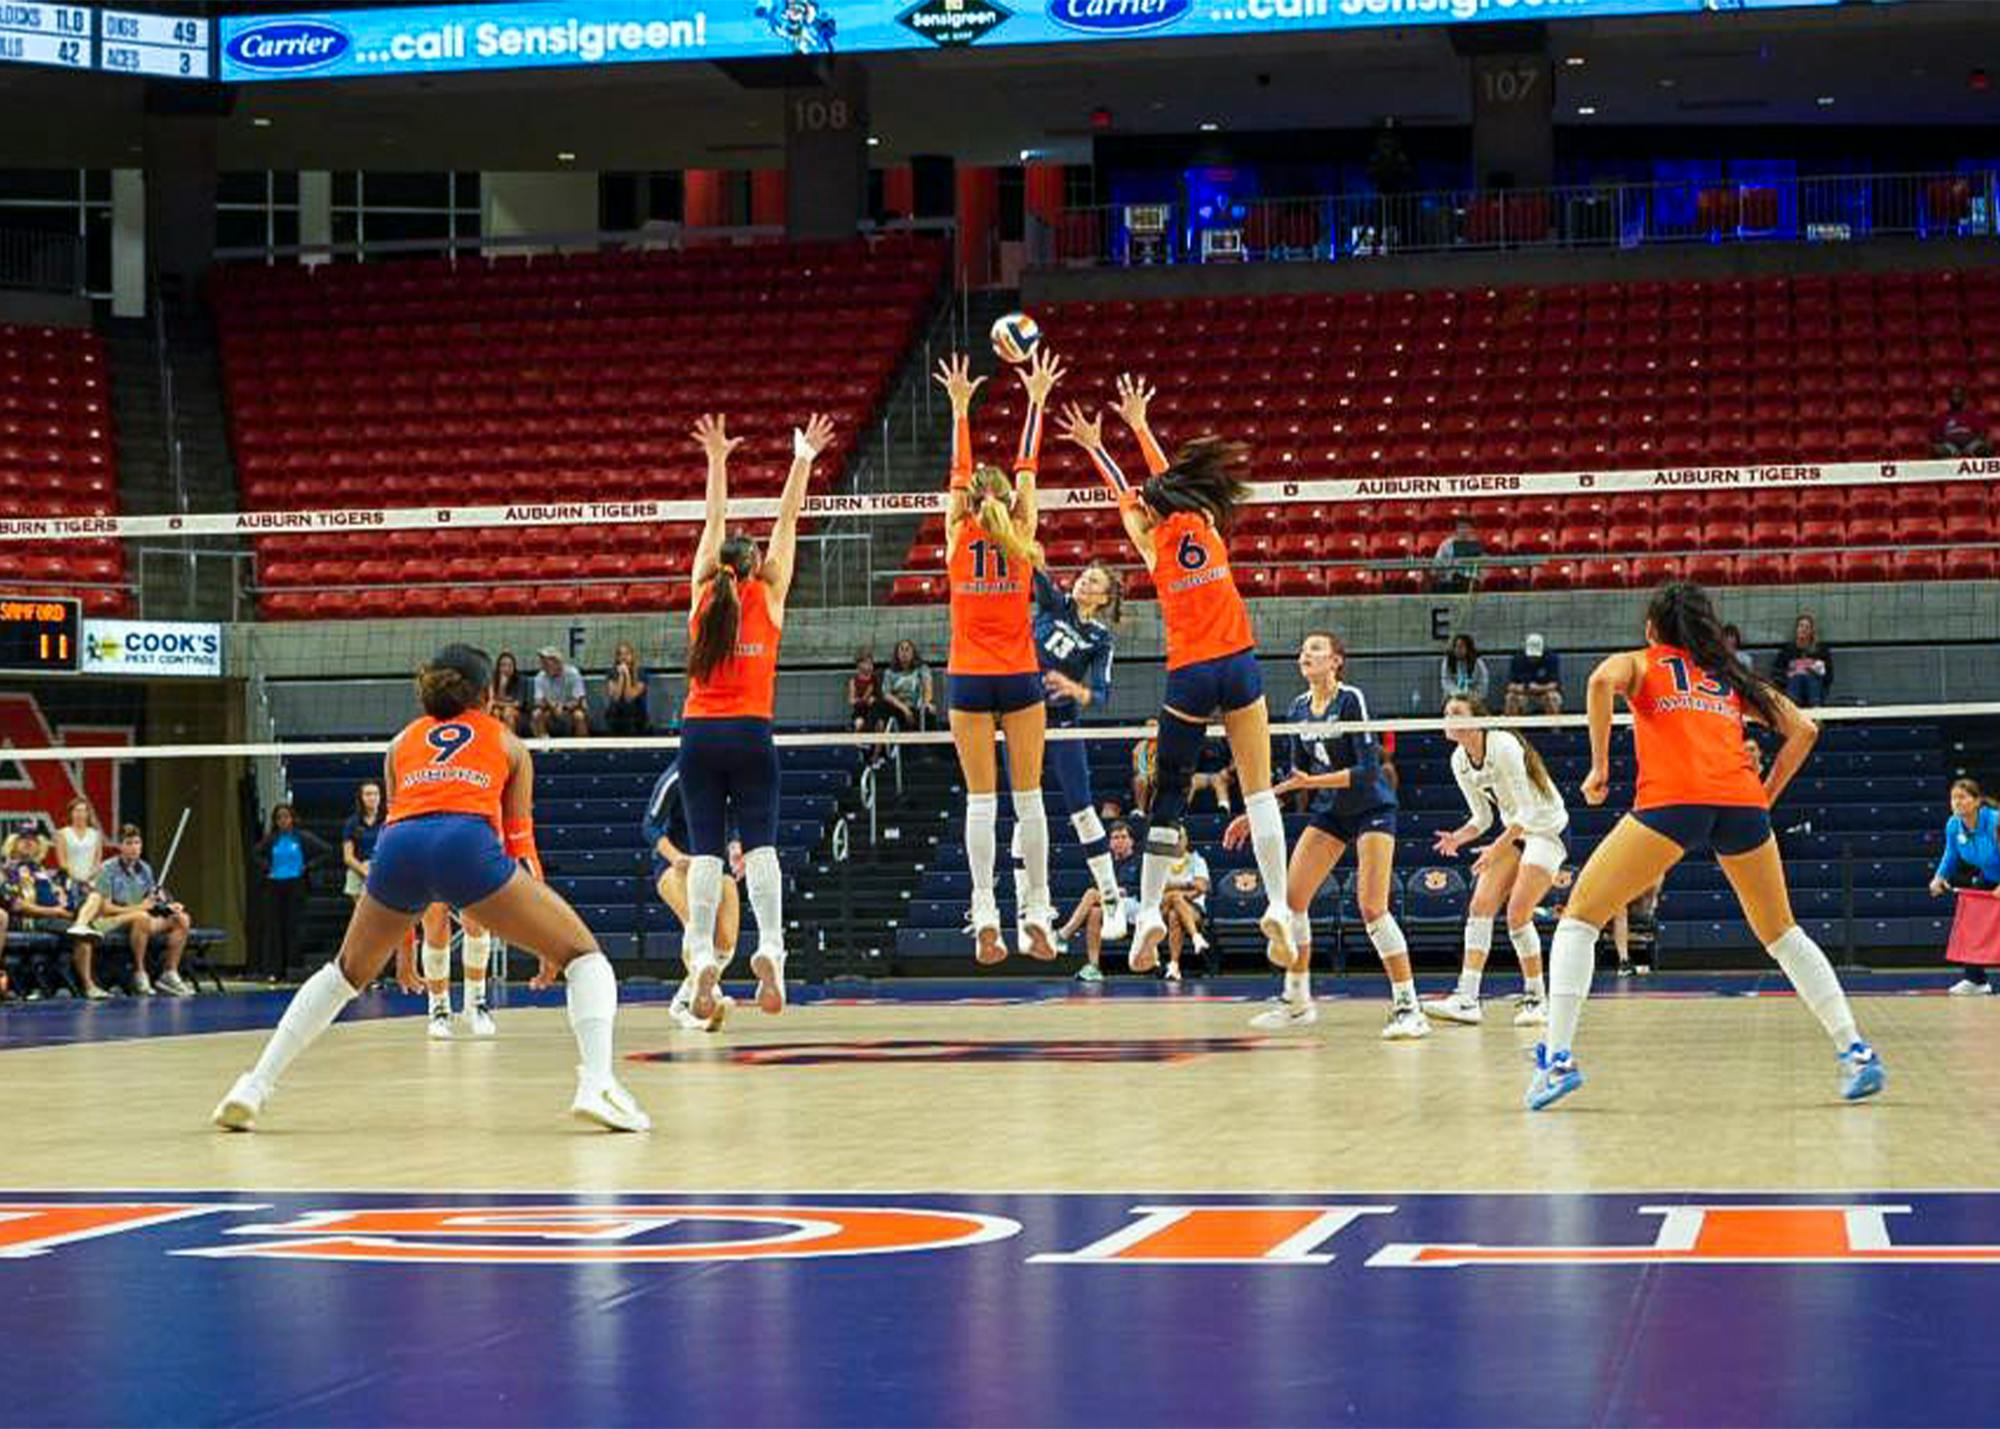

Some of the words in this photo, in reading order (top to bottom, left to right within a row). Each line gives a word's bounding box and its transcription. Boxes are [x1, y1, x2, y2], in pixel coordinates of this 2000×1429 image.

[912, 10, 997, 29] Sensigreen
[174, 22, 198, 43] 49
[475, 11, 708, 62] Sensigreen!
[57, 41, 81, 64] 42
[240, 31, 337, 58] Carrier
[179, 53, 191, 74] 3
[1486, 68, 1538, 103] 107
[795, 100, 848, 133] 108
[1355, 479, 1441, 495] AUBURN
[1448, 476, 1520, 491] TIGERS
[1654, 469, 1739, 485] AUBURN
[1748, 466, 1821, 482] TIGERS
[504, 505, 583, 521] AUBURN
[589, 502, 658, 518] TIGERS
[799, 496, 861, 511] UBURN
[871, 495, 940, 509] TIGERS
[54, 518, 118, 533] TIGERS
[235, 514, 312, 528] AUBURN
[318, 511, 385, 526] TIGERS
[969, 540, 1008, 578] 11
[1178, 531, 1207, 571] 6
[1431, 607, 1449, 640] E
[40, 633, 67, 659] 11
[124, 632, 218, 654] COOK'S
[569, 627, 584, 659] F
[426, 723, 476, 765] 9
